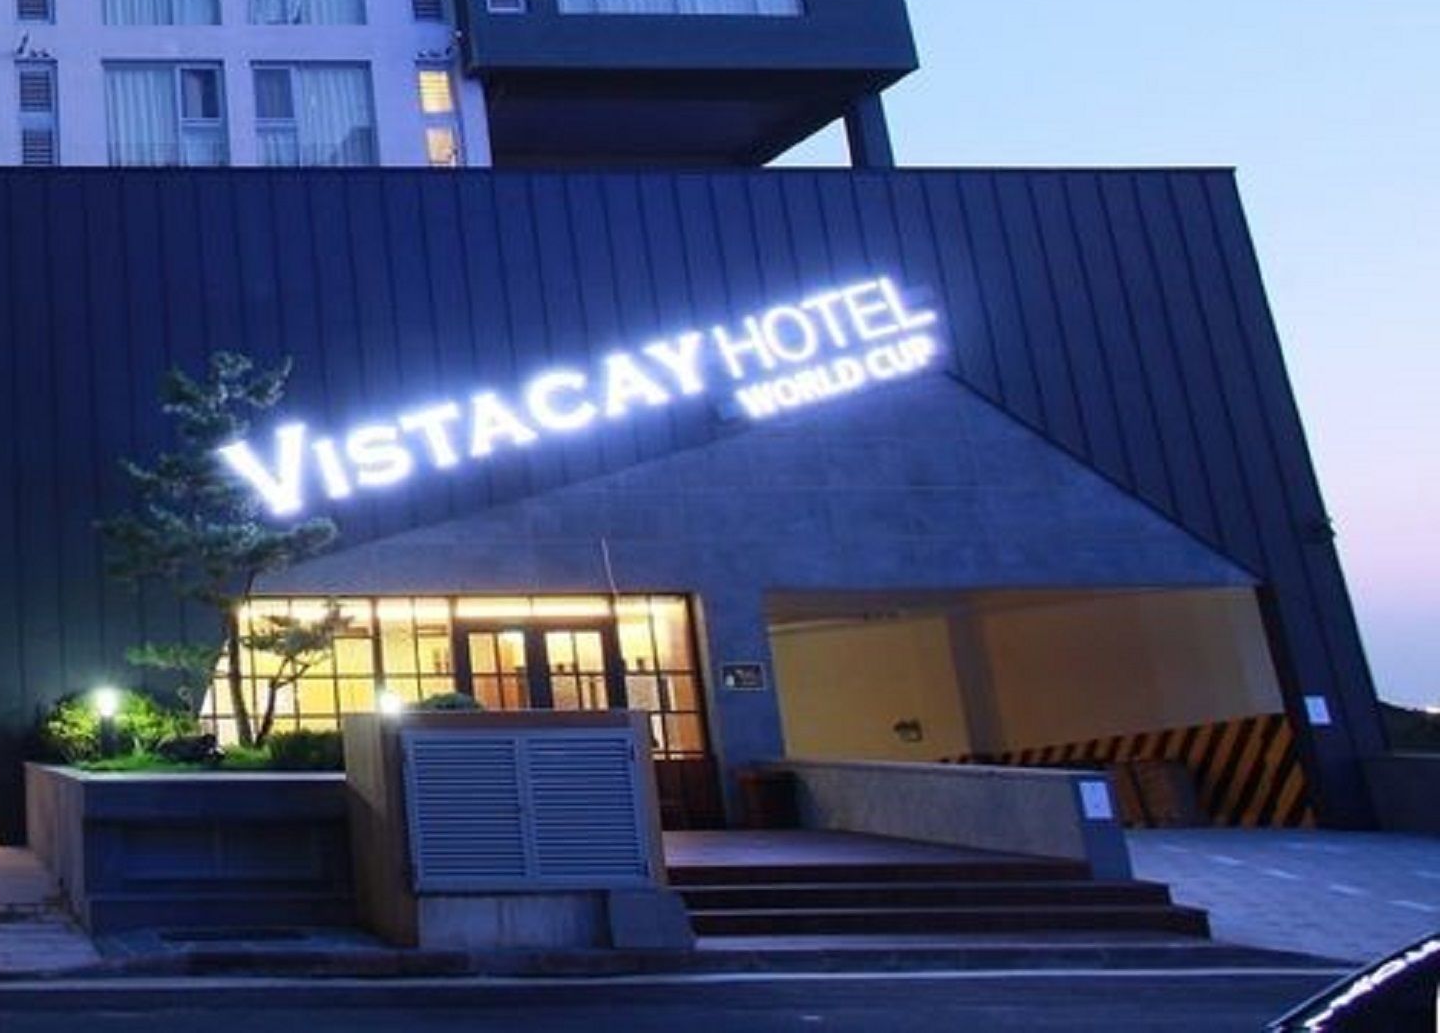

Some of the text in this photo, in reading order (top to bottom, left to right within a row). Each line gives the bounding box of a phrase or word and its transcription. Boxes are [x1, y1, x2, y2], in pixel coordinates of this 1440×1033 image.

[218, 276, 938, 517] VISTACAY HOTEL
[735, 334, 937, 419] WORLD CUP
